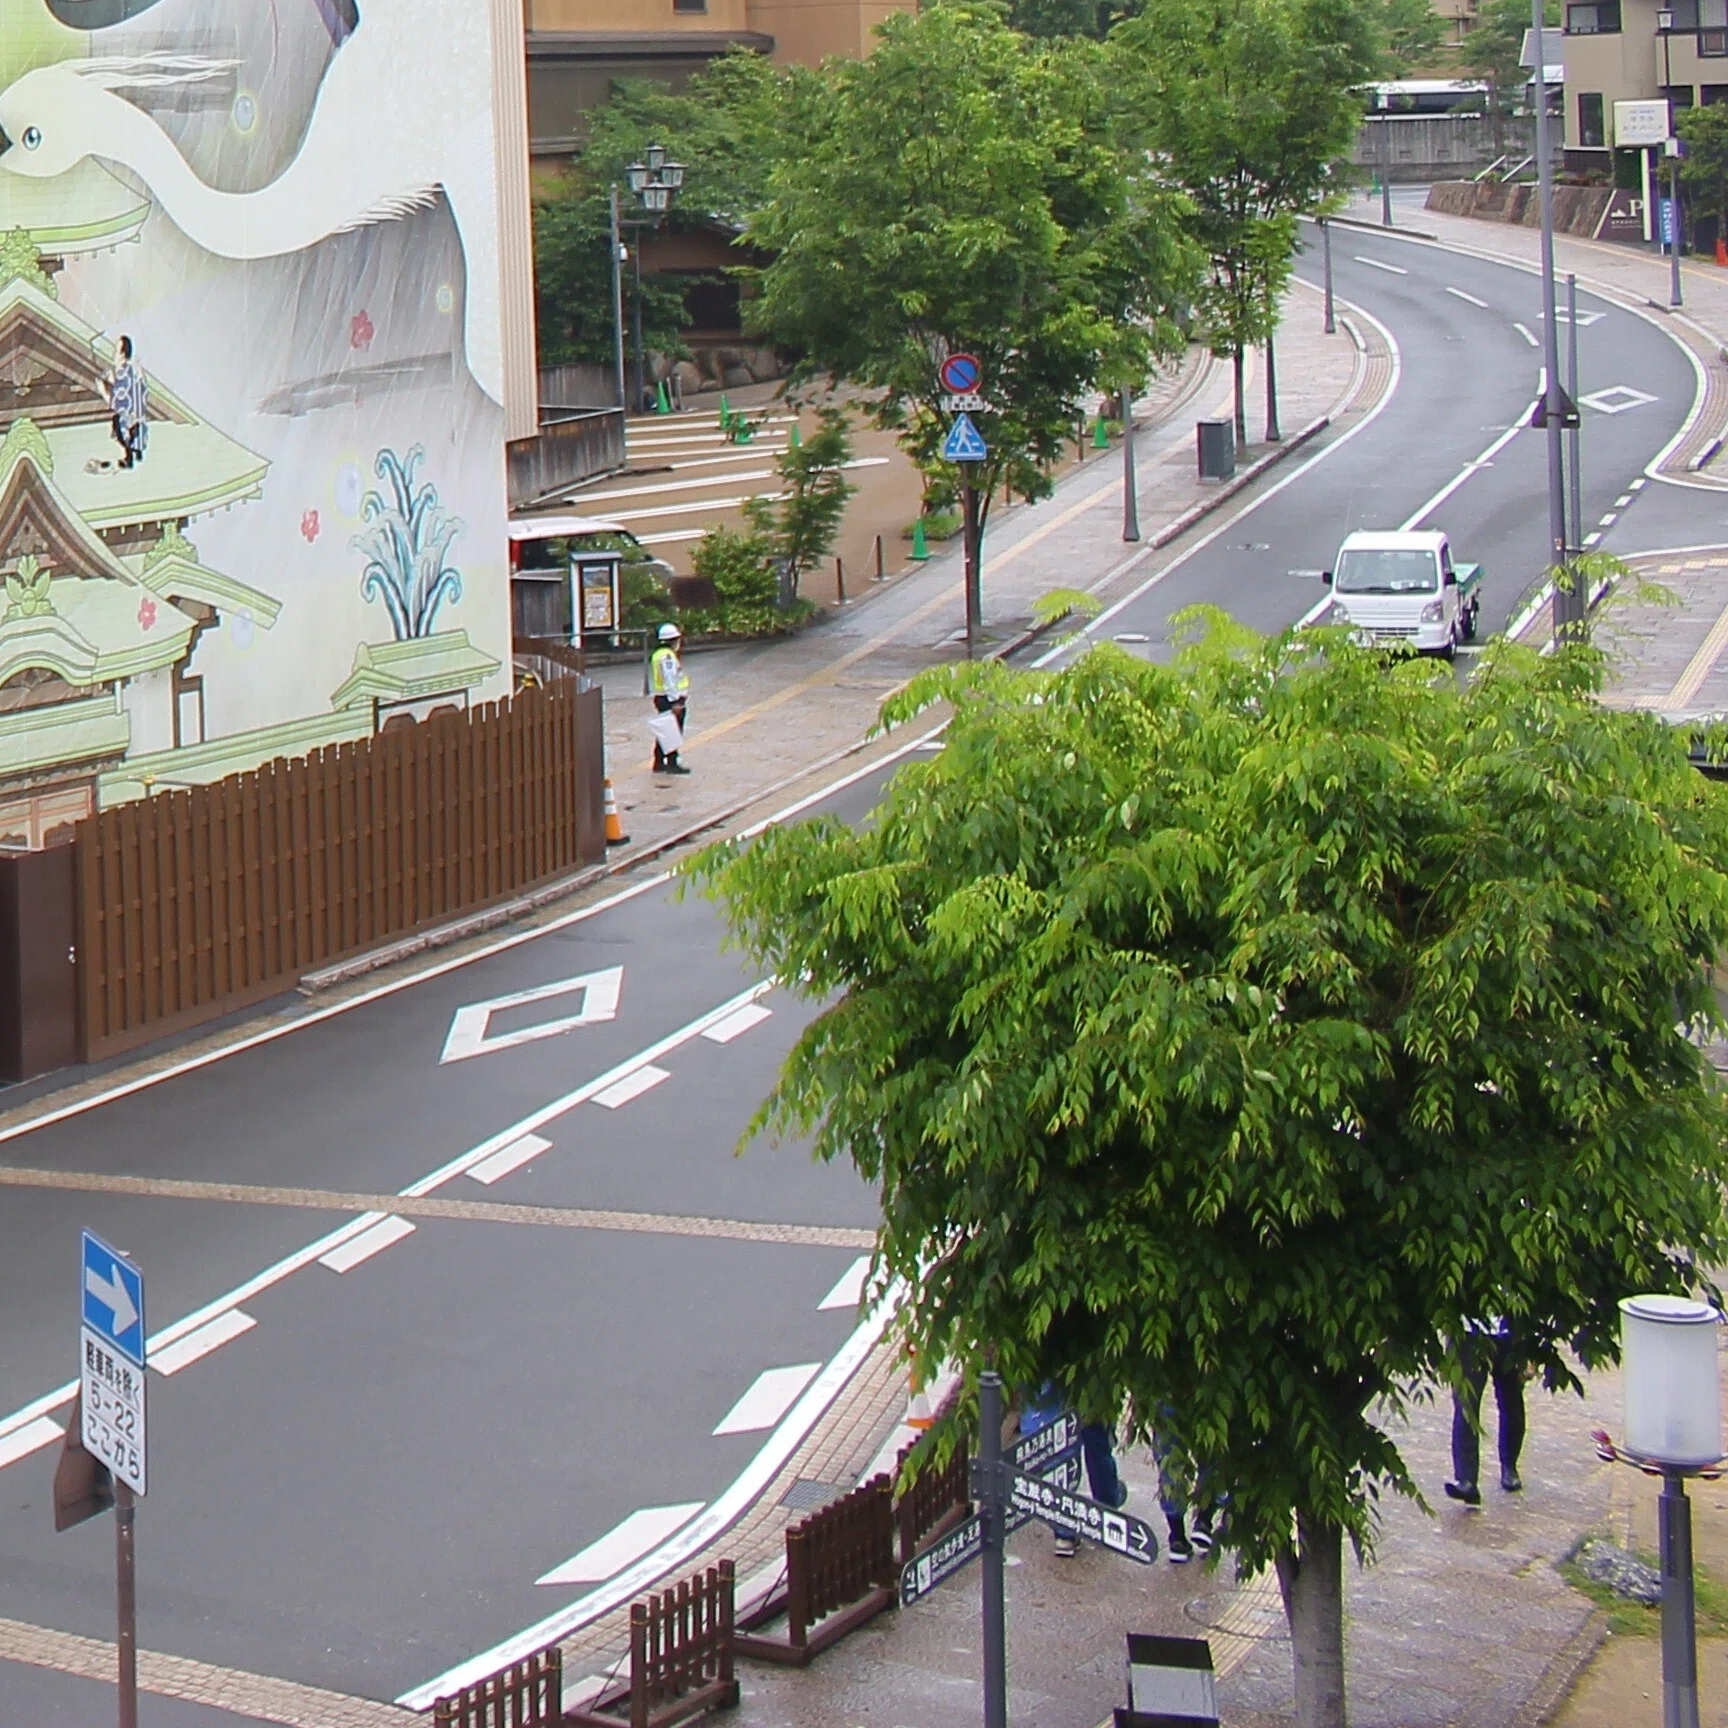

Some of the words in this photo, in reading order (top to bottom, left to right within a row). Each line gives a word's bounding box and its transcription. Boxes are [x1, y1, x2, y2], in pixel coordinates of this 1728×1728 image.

[91, 1379, 136, 1441] 5-22
[87, 1413, 141, 1481] ここから
